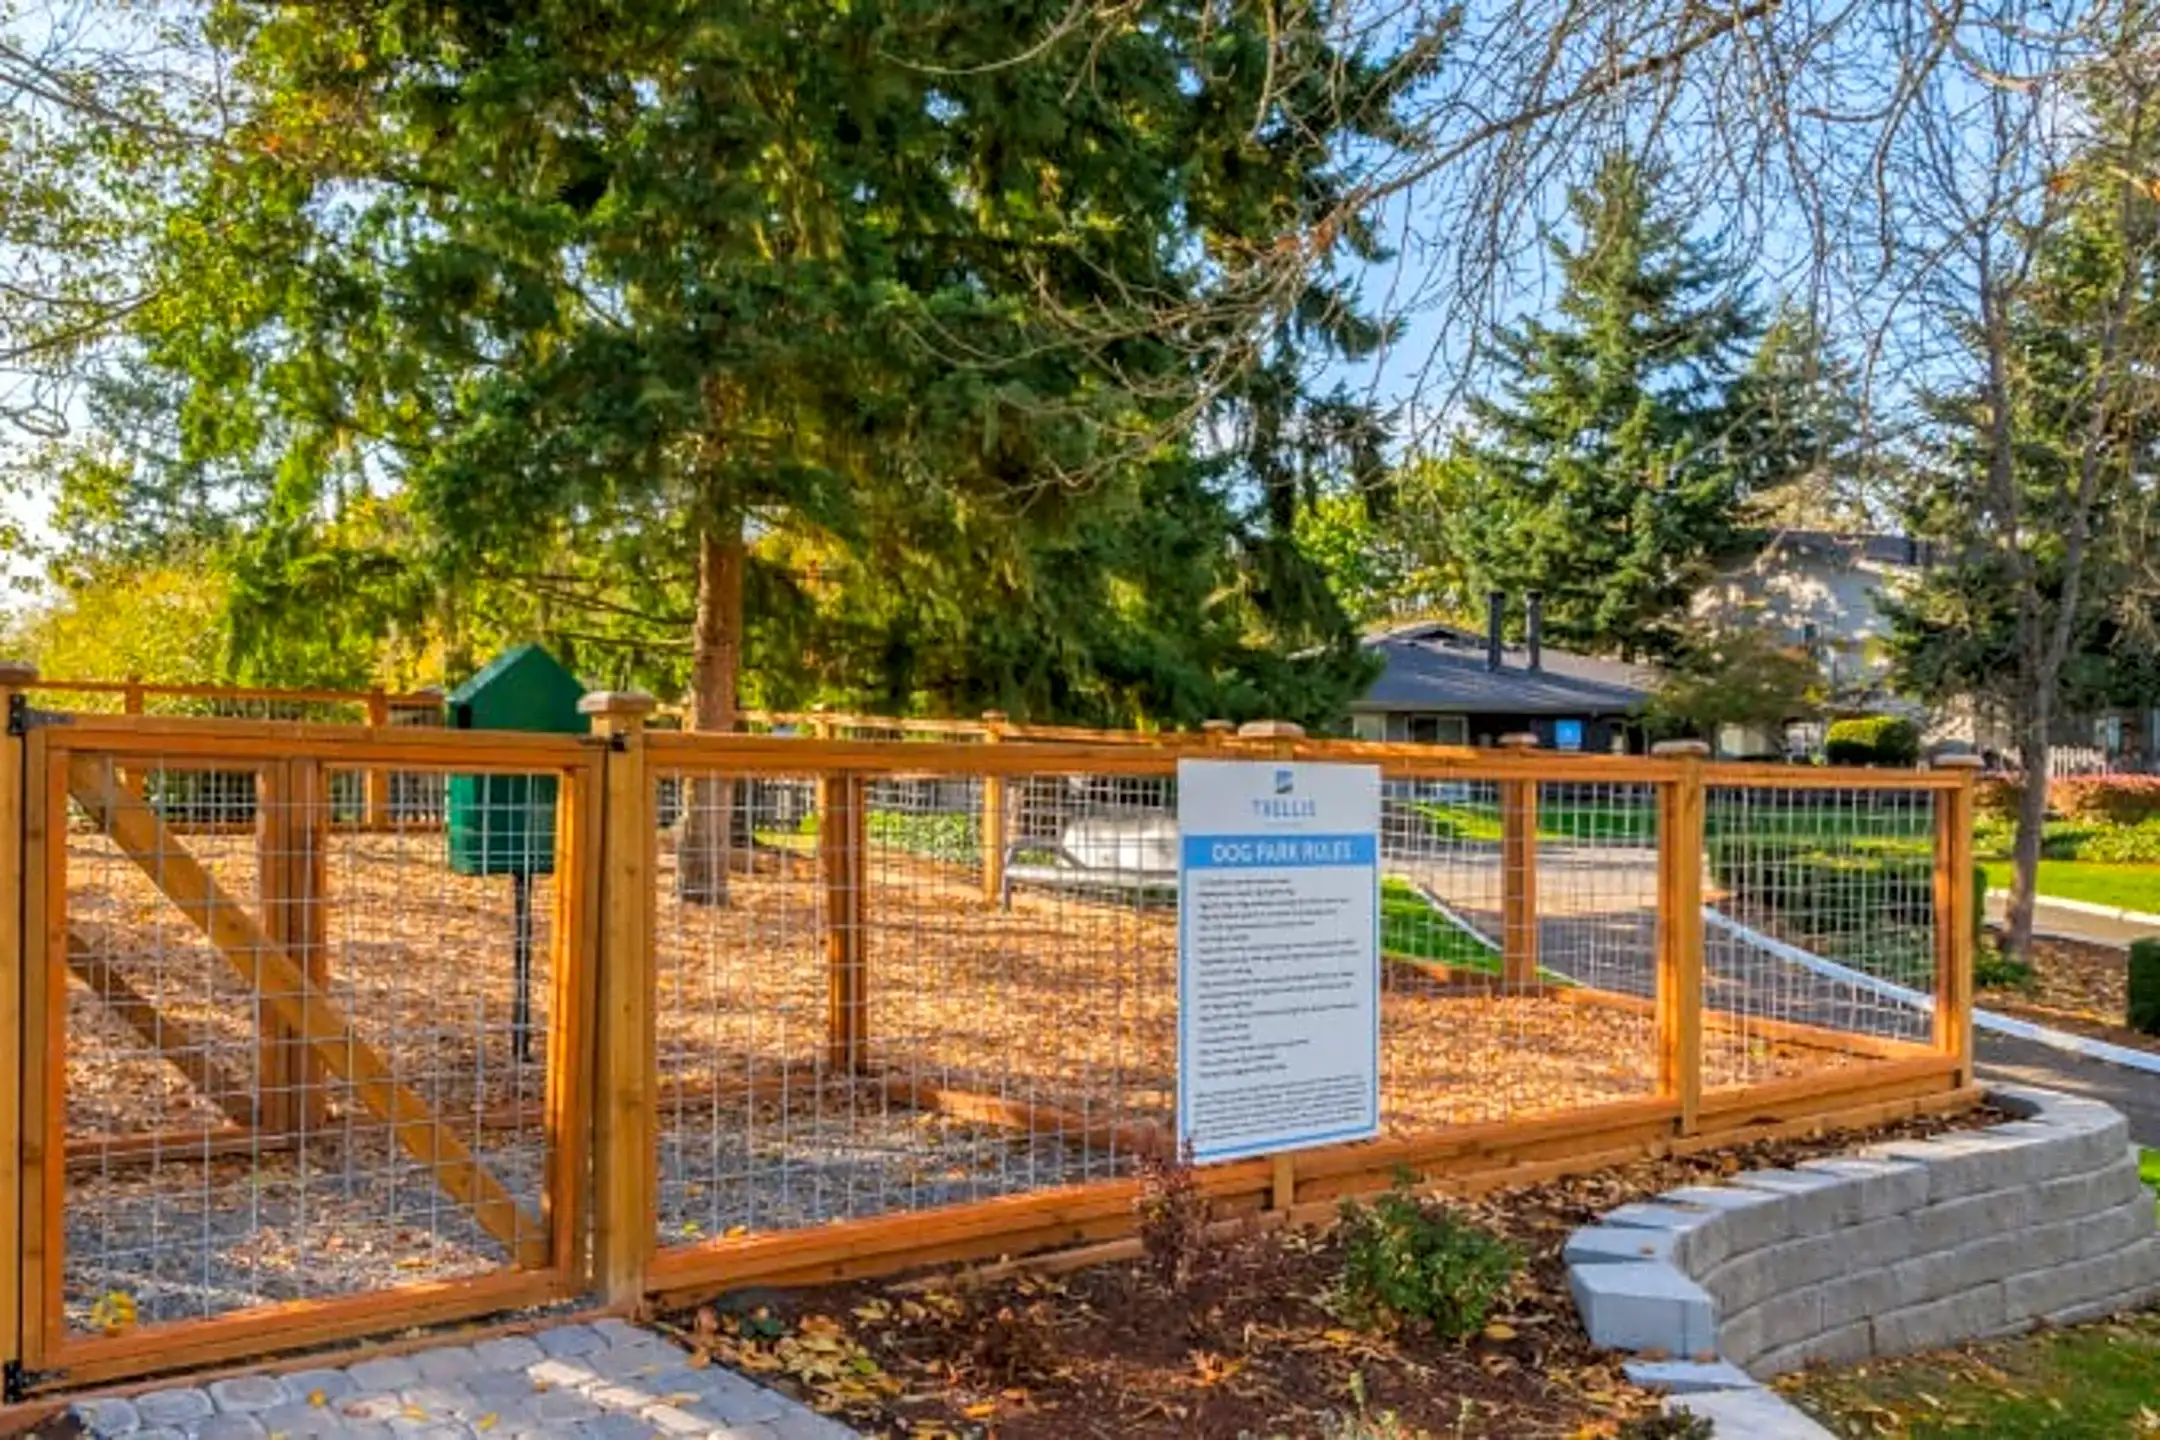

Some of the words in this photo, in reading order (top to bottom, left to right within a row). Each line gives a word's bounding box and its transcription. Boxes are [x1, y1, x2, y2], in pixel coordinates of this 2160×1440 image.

[1212, 842, 1252, 862] DOG
[1256, 840, 1298, 862] PARK
[1301, 839, 1351, 861] RULES
